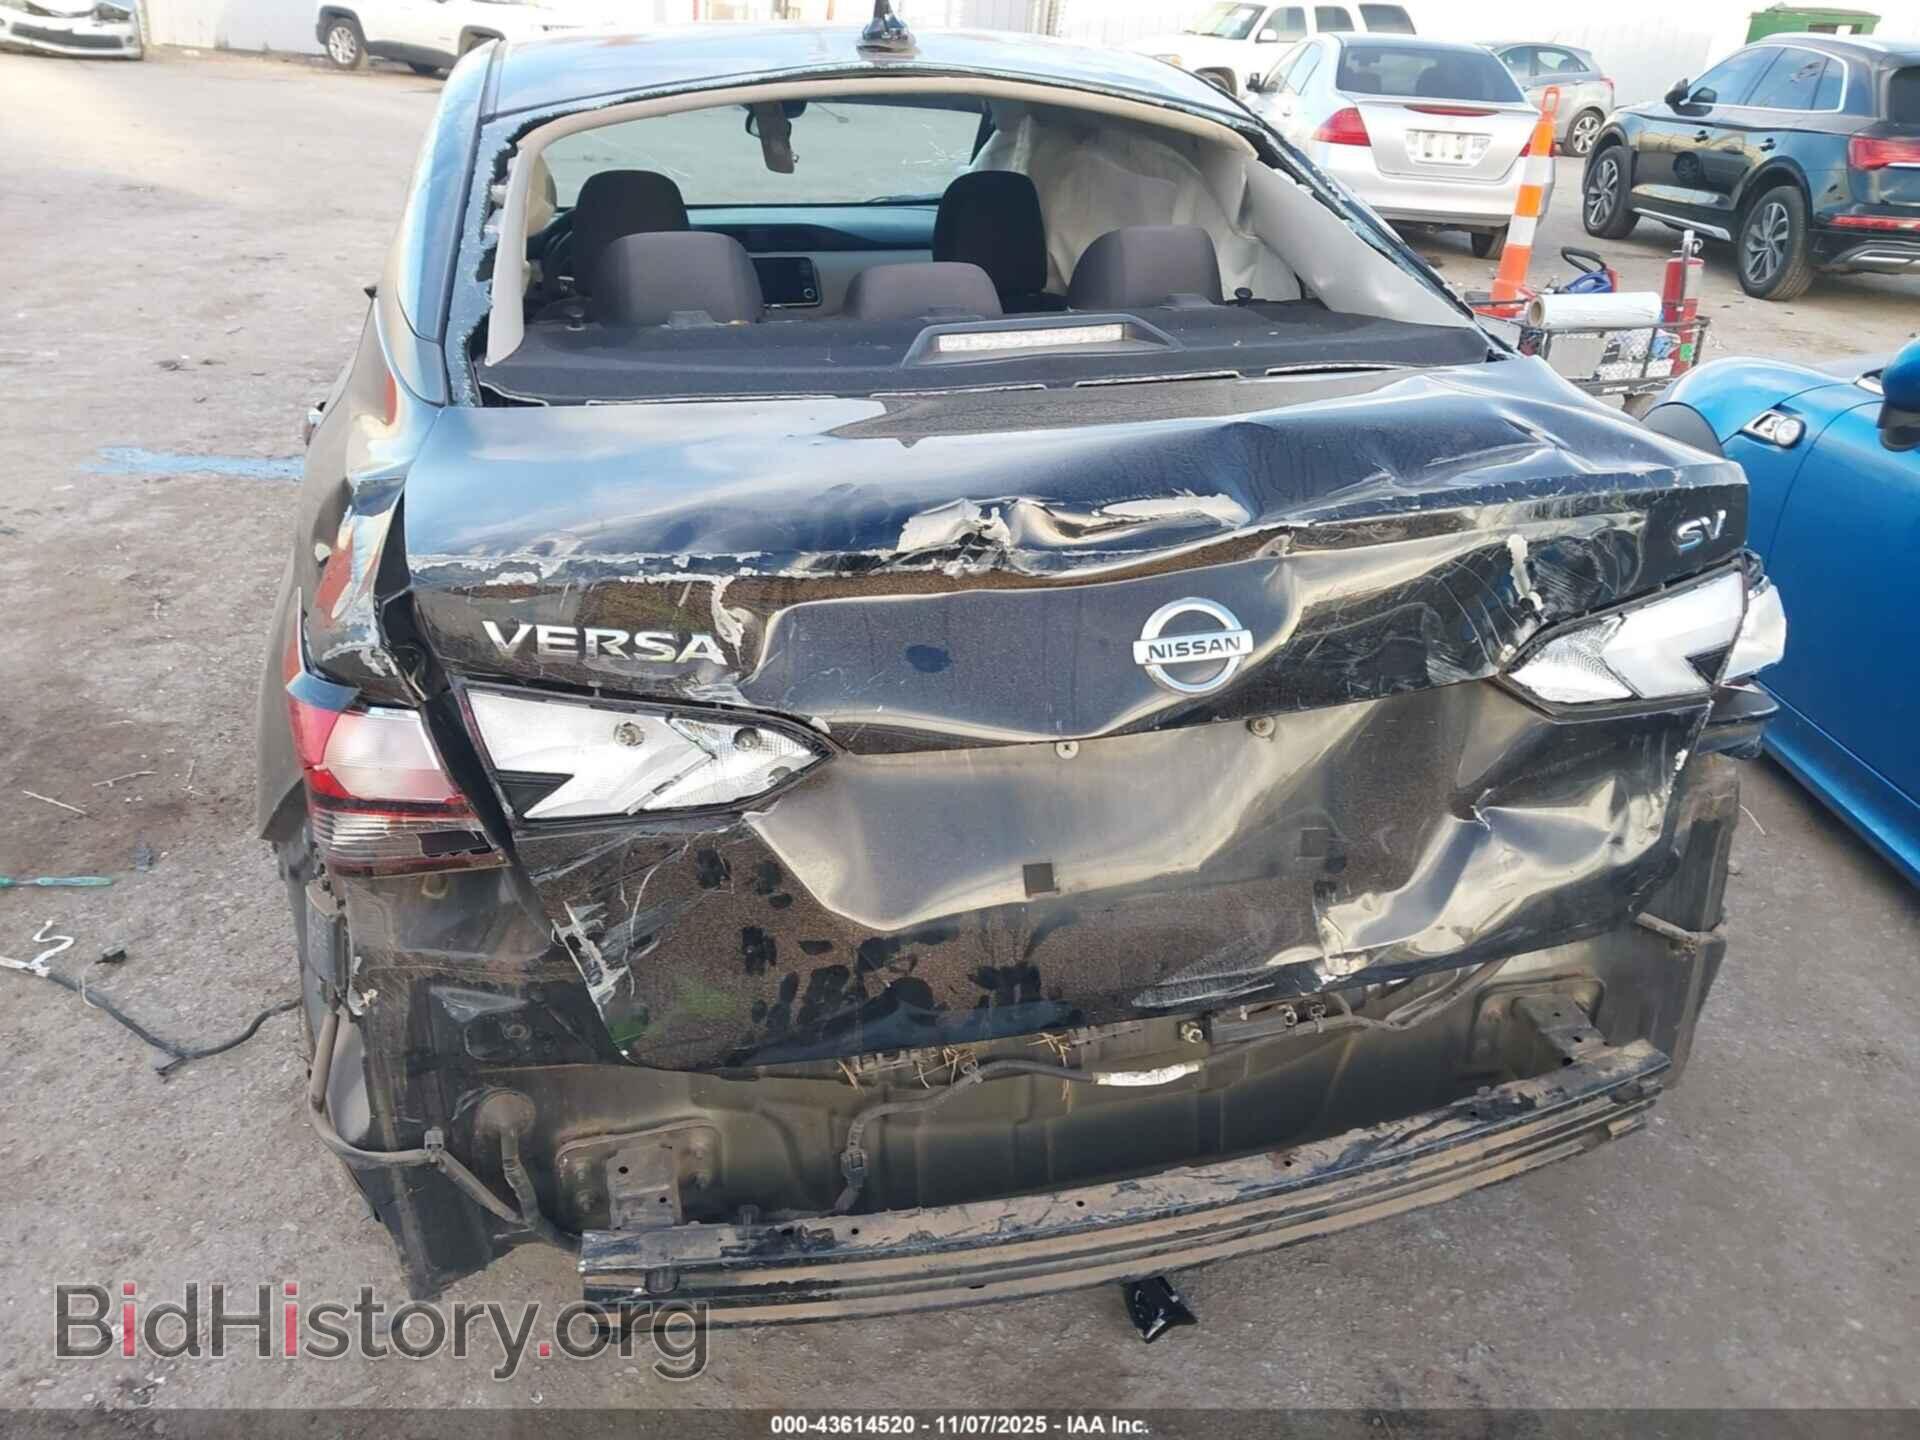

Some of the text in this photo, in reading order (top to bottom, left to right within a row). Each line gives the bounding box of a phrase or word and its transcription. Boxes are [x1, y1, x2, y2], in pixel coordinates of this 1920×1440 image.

[1675, 509, 1727, 550] SV
[482, 620, 728, 666] VERSA
[1148, 636, 1240, 660] NISSAN
